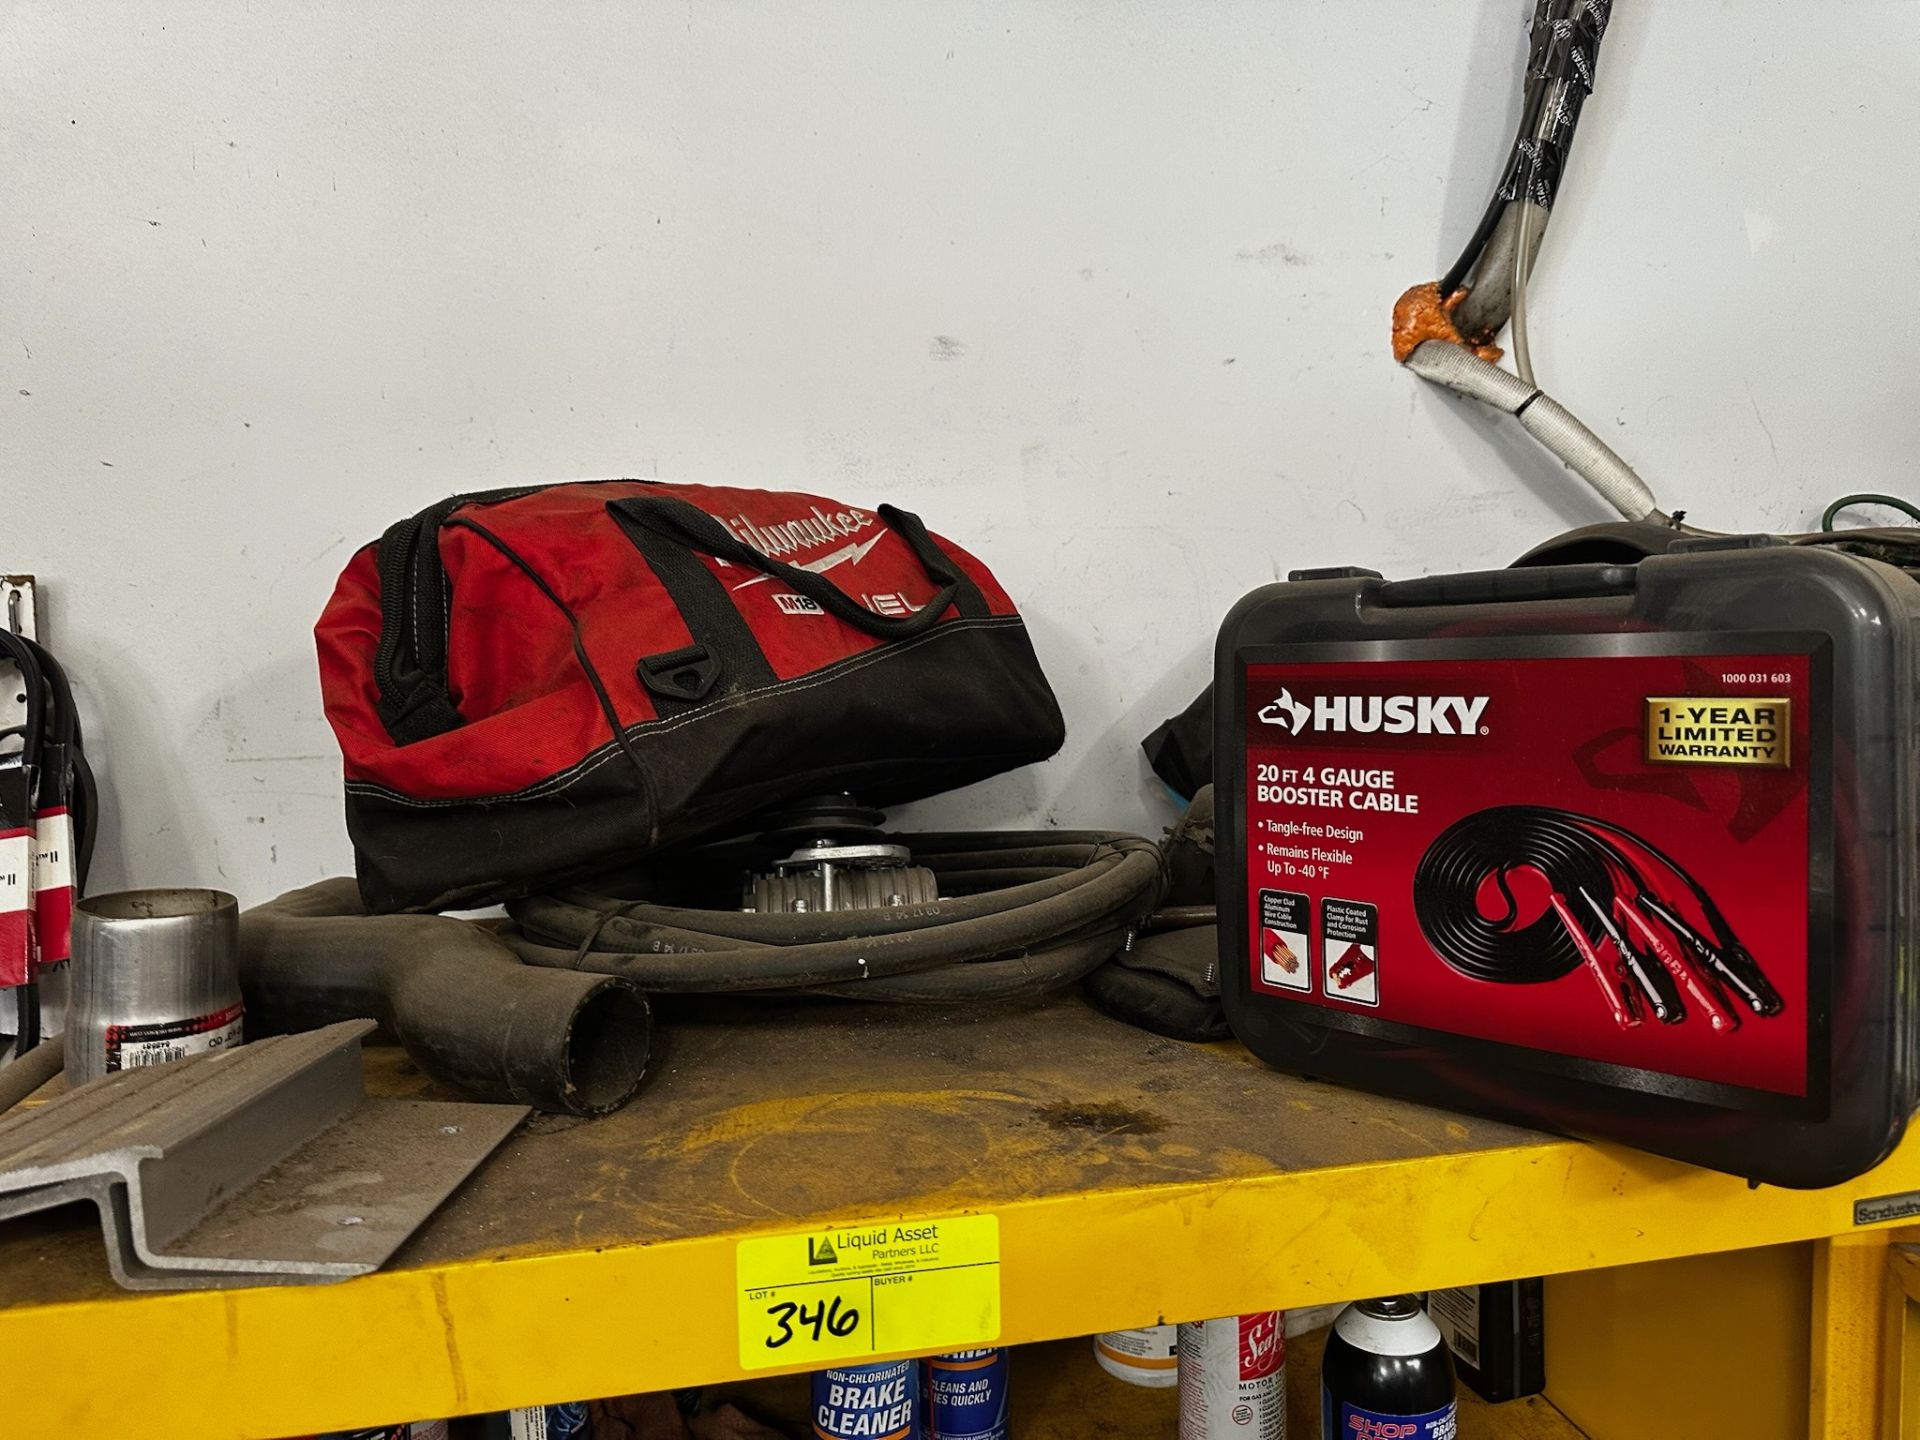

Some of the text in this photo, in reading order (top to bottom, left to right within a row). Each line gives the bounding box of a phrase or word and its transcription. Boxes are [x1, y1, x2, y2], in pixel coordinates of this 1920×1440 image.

[1721, 674, 1791, 683] 1000 031 603
[1314, 696, 1490, 735] HUSKY
[1659, 708, 1776, 725] 1-YEAR
[1658, 727, 1777, 743] LIMITED
[1658, 744, 1776, 759] WARRANTY
[1257, 764, 1394, 789] 20 FT 4 GAUGE
[1257, 785, 1419, 813] BOOSTER CABLE
[1266, 819, 1363, 842] Tangle-free Design
[1267, 843, 1353, 865] Remains Flexible
[1267, 860, 1330, 880] Up To -40 °F
[1263, 895, 1295, 907] Copper Clad
[1277, 912, 1292, 921] Cable
[1326, 904, 1367, 918] Plastic Coated
[1326, 912, 1369, 926] Clamp for Rust
[1264, 918, 1297, 929] Construction
[1326, 921, 1366, 933] and Corrosion
[1326, 929, 1356, 939] Protection
[837, 1229, 888, 1250] Liquid
[893, 1224, 939, 1243] Asset
[872, 1242, 939, 1260] Partners LLC
[874, 1276, 906, 1287] BUYER
[749, 1291, 768, 1301] LOT
[765, 1296, 859, 1349] 346
[826, 1360, 910, 1384] NON-CHLORINATED
[968, 1378, 988, 1393] AND
[1238, 1377, 1273, 1391] MOTOR
[829, 1376, 906, 1411] BRAKE
[951, 1389, 991, 1407] QUICKLY
[818, 1398, 912, 1436] CLEANER
[1348, 1414, 1418, 1439] SHOP
